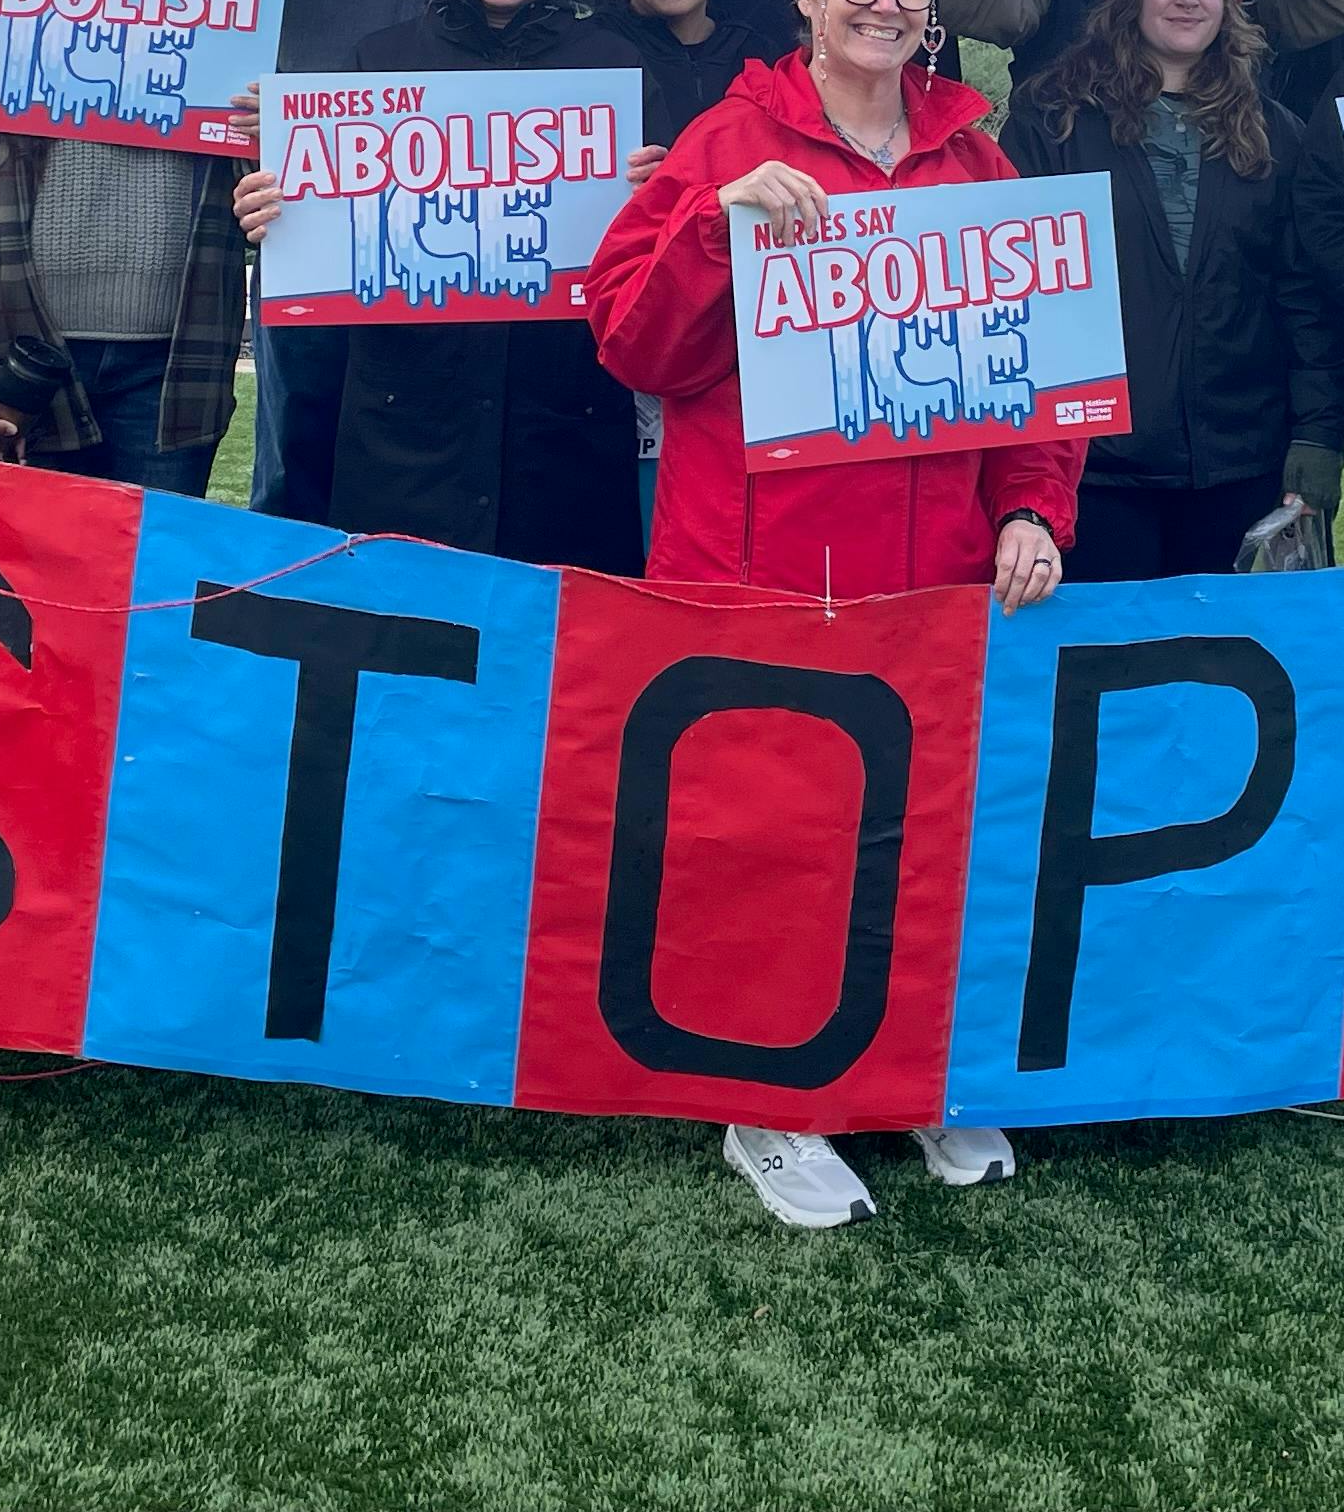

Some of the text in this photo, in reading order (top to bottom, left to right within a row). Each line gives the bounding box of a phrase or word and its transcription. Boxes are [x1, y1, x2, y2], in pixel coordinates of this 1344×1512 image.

[0, 10, 197, 137] ICE
[283, 86, 426, 120] NURSES SAY
[279, 104, 616, 201] ABOLISH
[350, 182, 552, 308] ICE
[754, 210, 1093, 338] ABOLISH
[855, 204, 896, 238] SAY
[828, 296, 1037, 441] ICE
